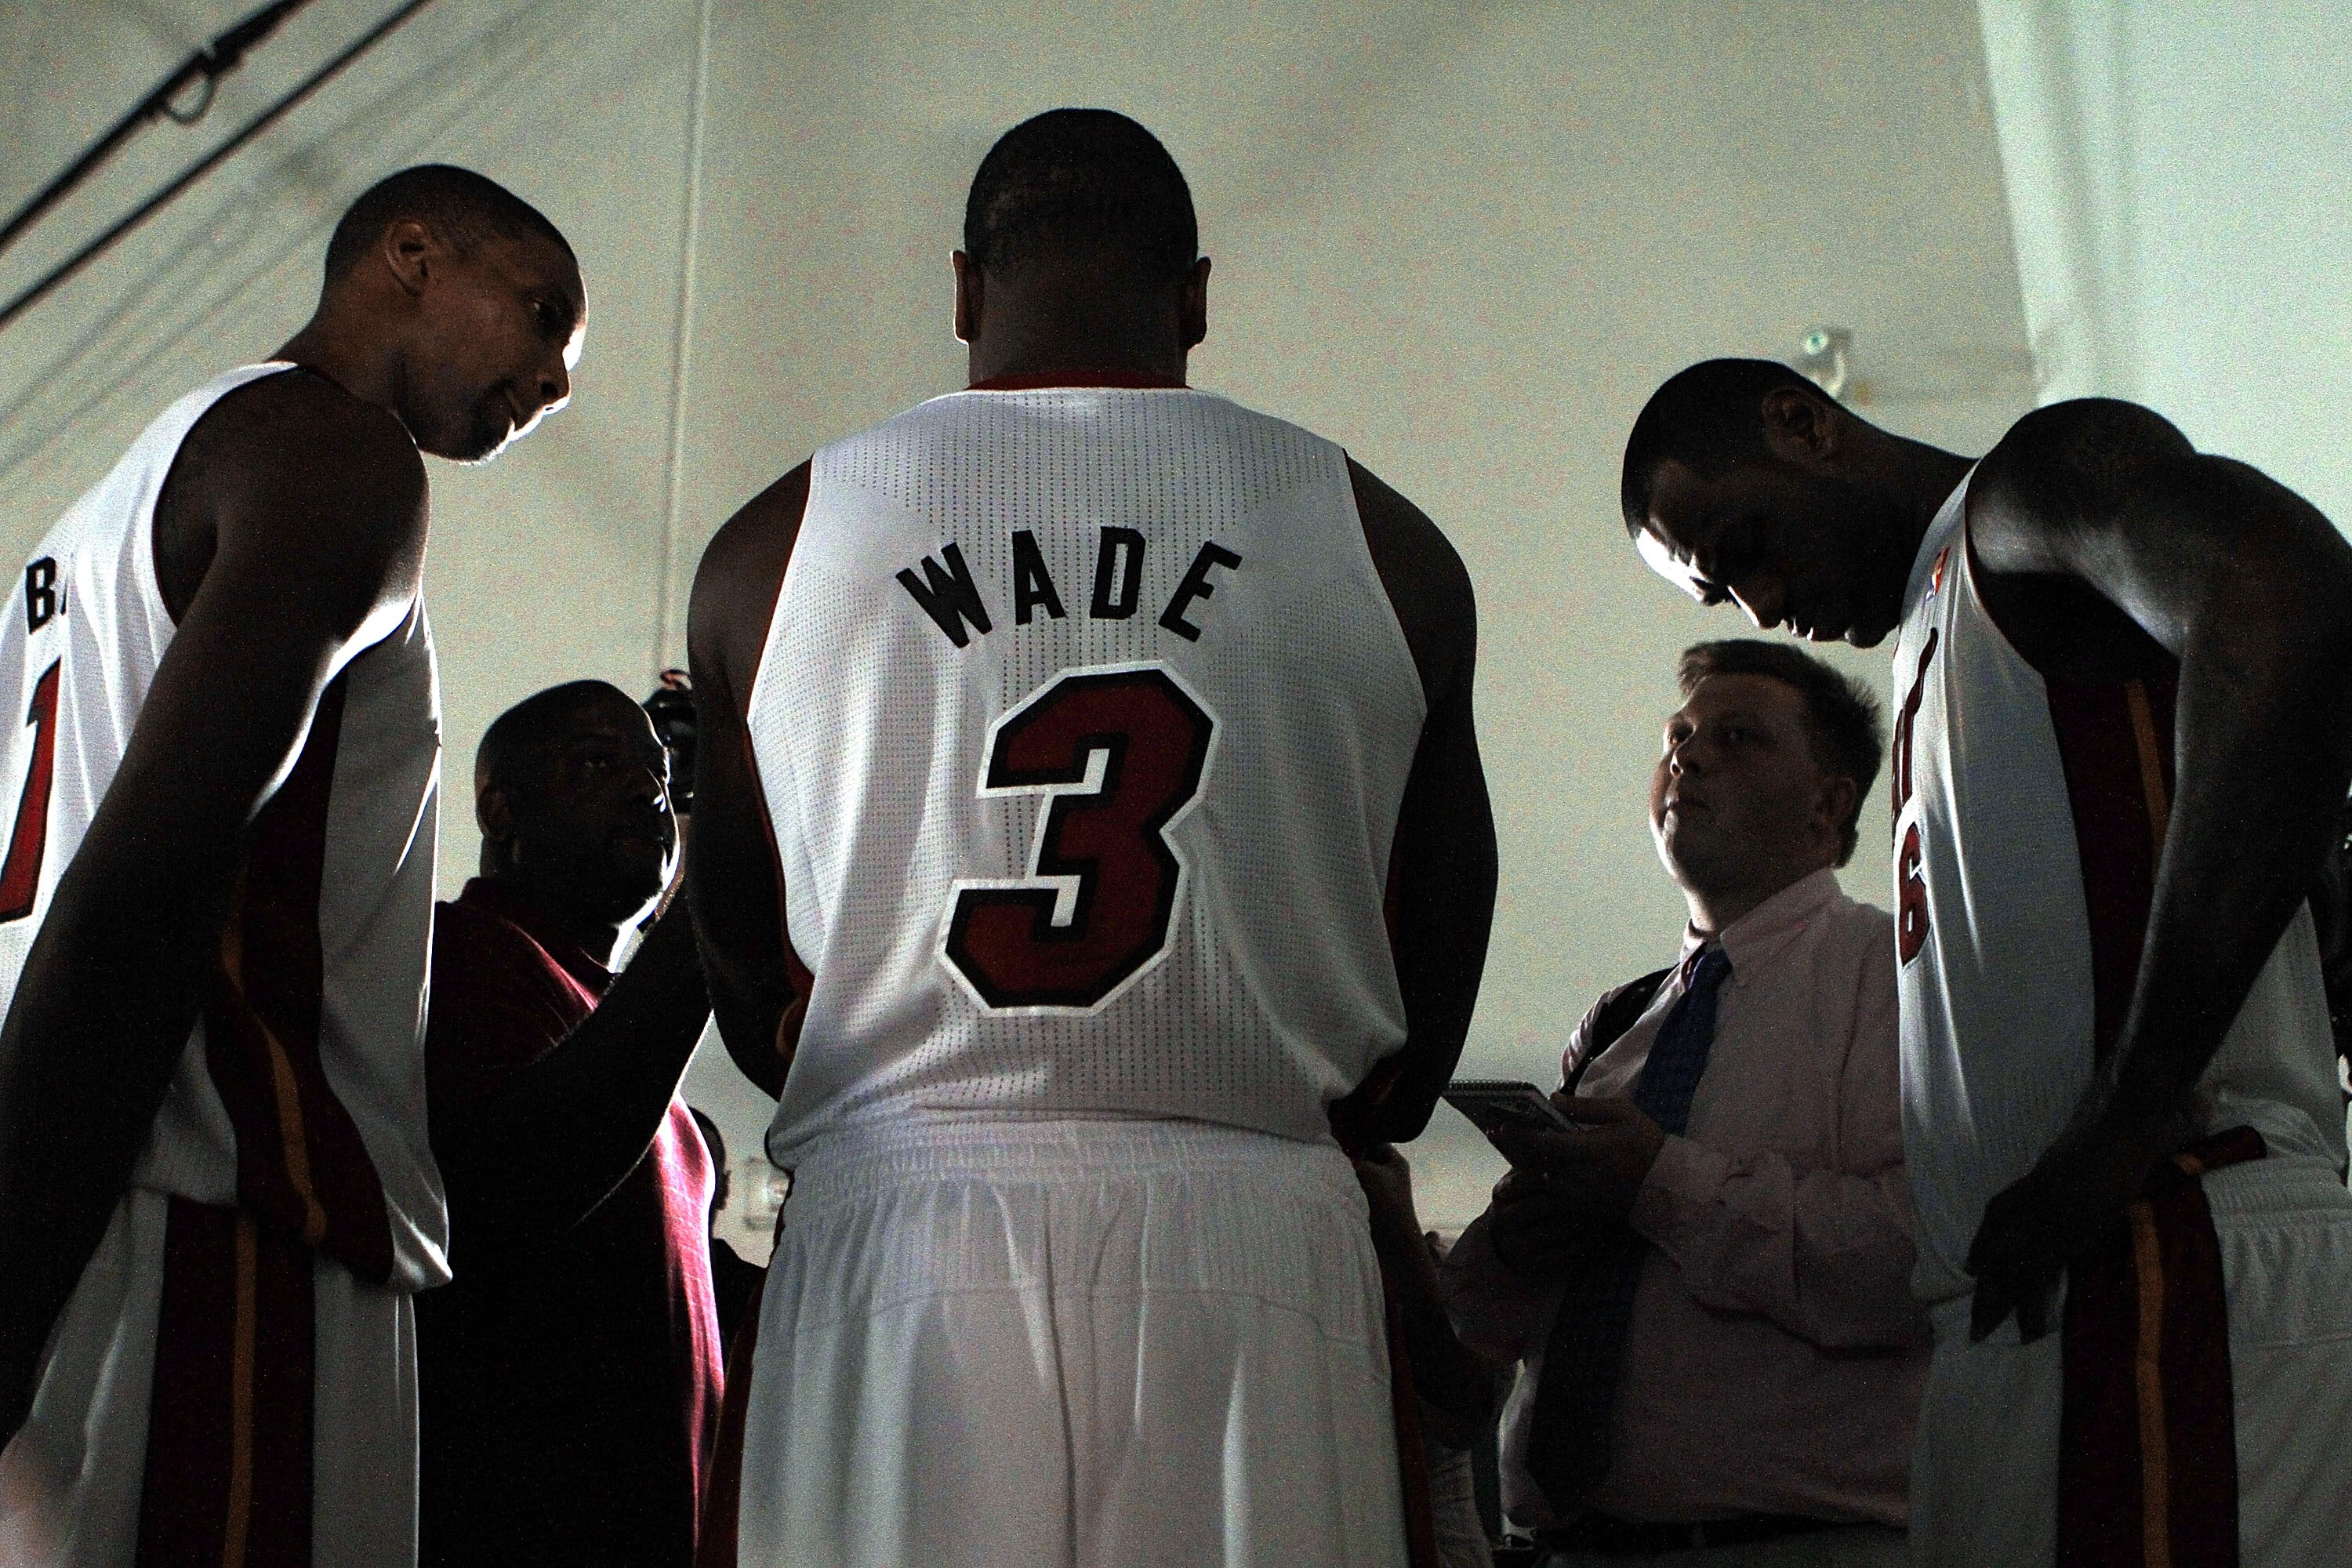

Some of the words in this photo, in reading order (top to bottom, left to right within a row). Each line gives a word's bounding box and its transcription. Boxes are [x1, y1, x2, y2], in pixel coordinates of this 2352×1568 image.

[26, 556, 67, 635] B
[896, 527, 1242, 648] WADE
[0, 657, 62, 923] 1
[943, 664, 1218, 1013] 3
